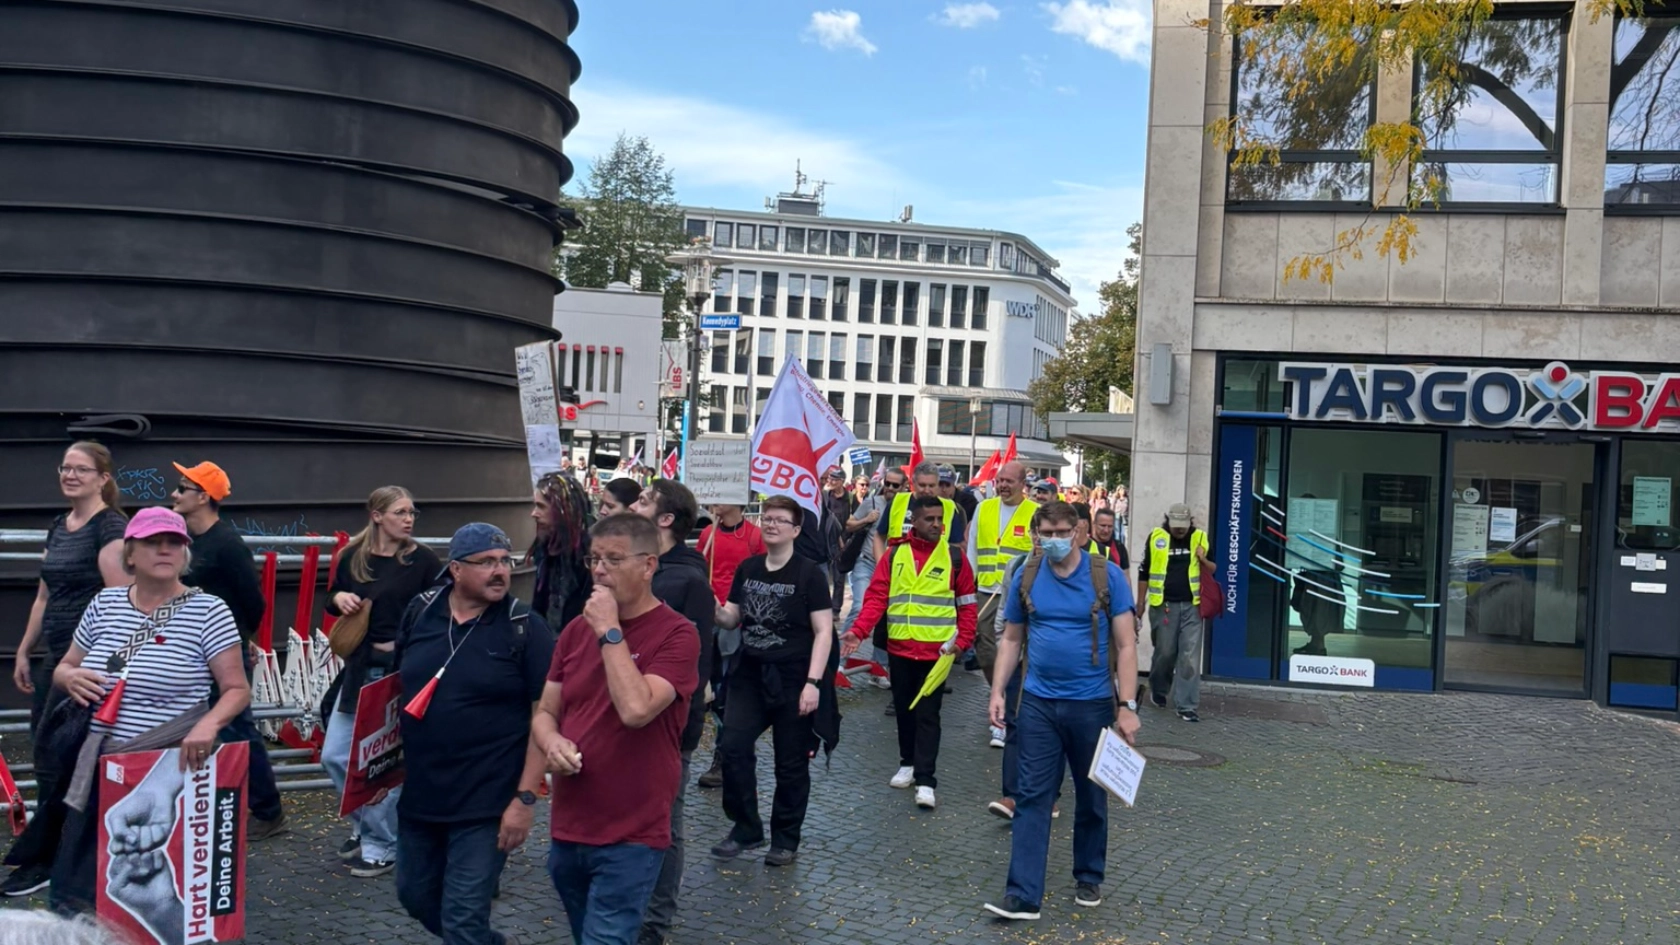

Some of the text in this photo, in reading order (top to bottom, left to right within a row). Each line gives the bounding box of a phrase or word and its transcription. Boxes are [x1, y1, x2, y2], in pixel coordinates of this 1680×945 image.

[672, 366, 683, 389] LBS
[1284, 367, 1680, 429] TARGO BA
[751, 456, 820, 509] IGBC
[1226, 459, 1243, 614] AUCH FÜR GESCHÄFTSKUNDEN
[1296, 665, 1368, 678] TARGO BANK
[216, 792, 235, 910] Deine Arbeit.
[188, 882, 207, 939] Hart
